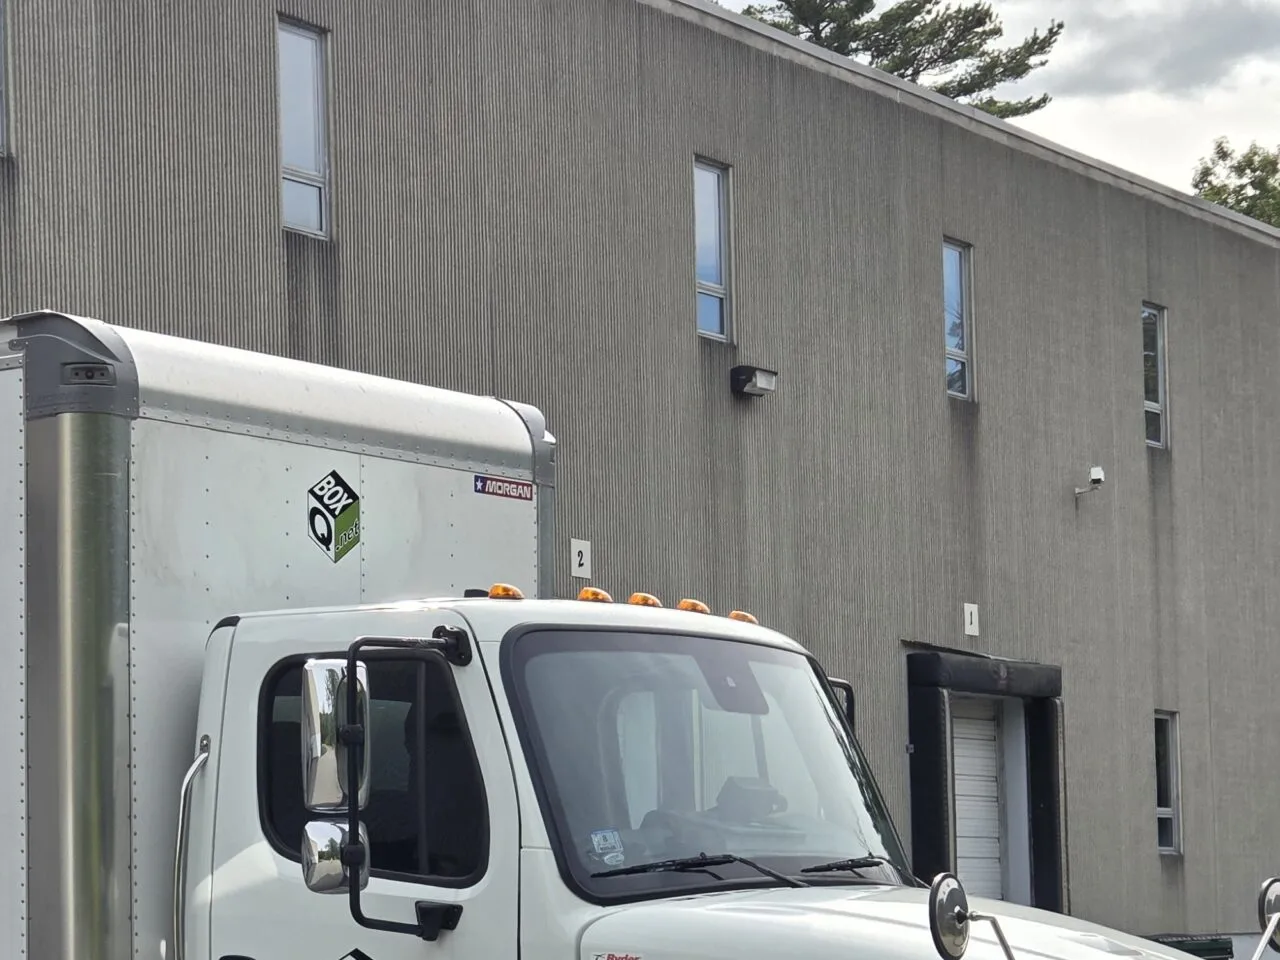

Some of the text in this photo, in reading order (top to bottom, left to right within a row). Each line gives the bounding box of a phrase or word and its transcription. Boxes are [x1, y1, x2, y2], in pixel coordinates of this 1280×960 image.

[312, 475, 354, 515] BOX
[485, 480, 532, 499] MORGAN
[309, 506, 333, 552] Q
[335, 518, 360, 552] .net
[577, 549, 585, 568] 2
